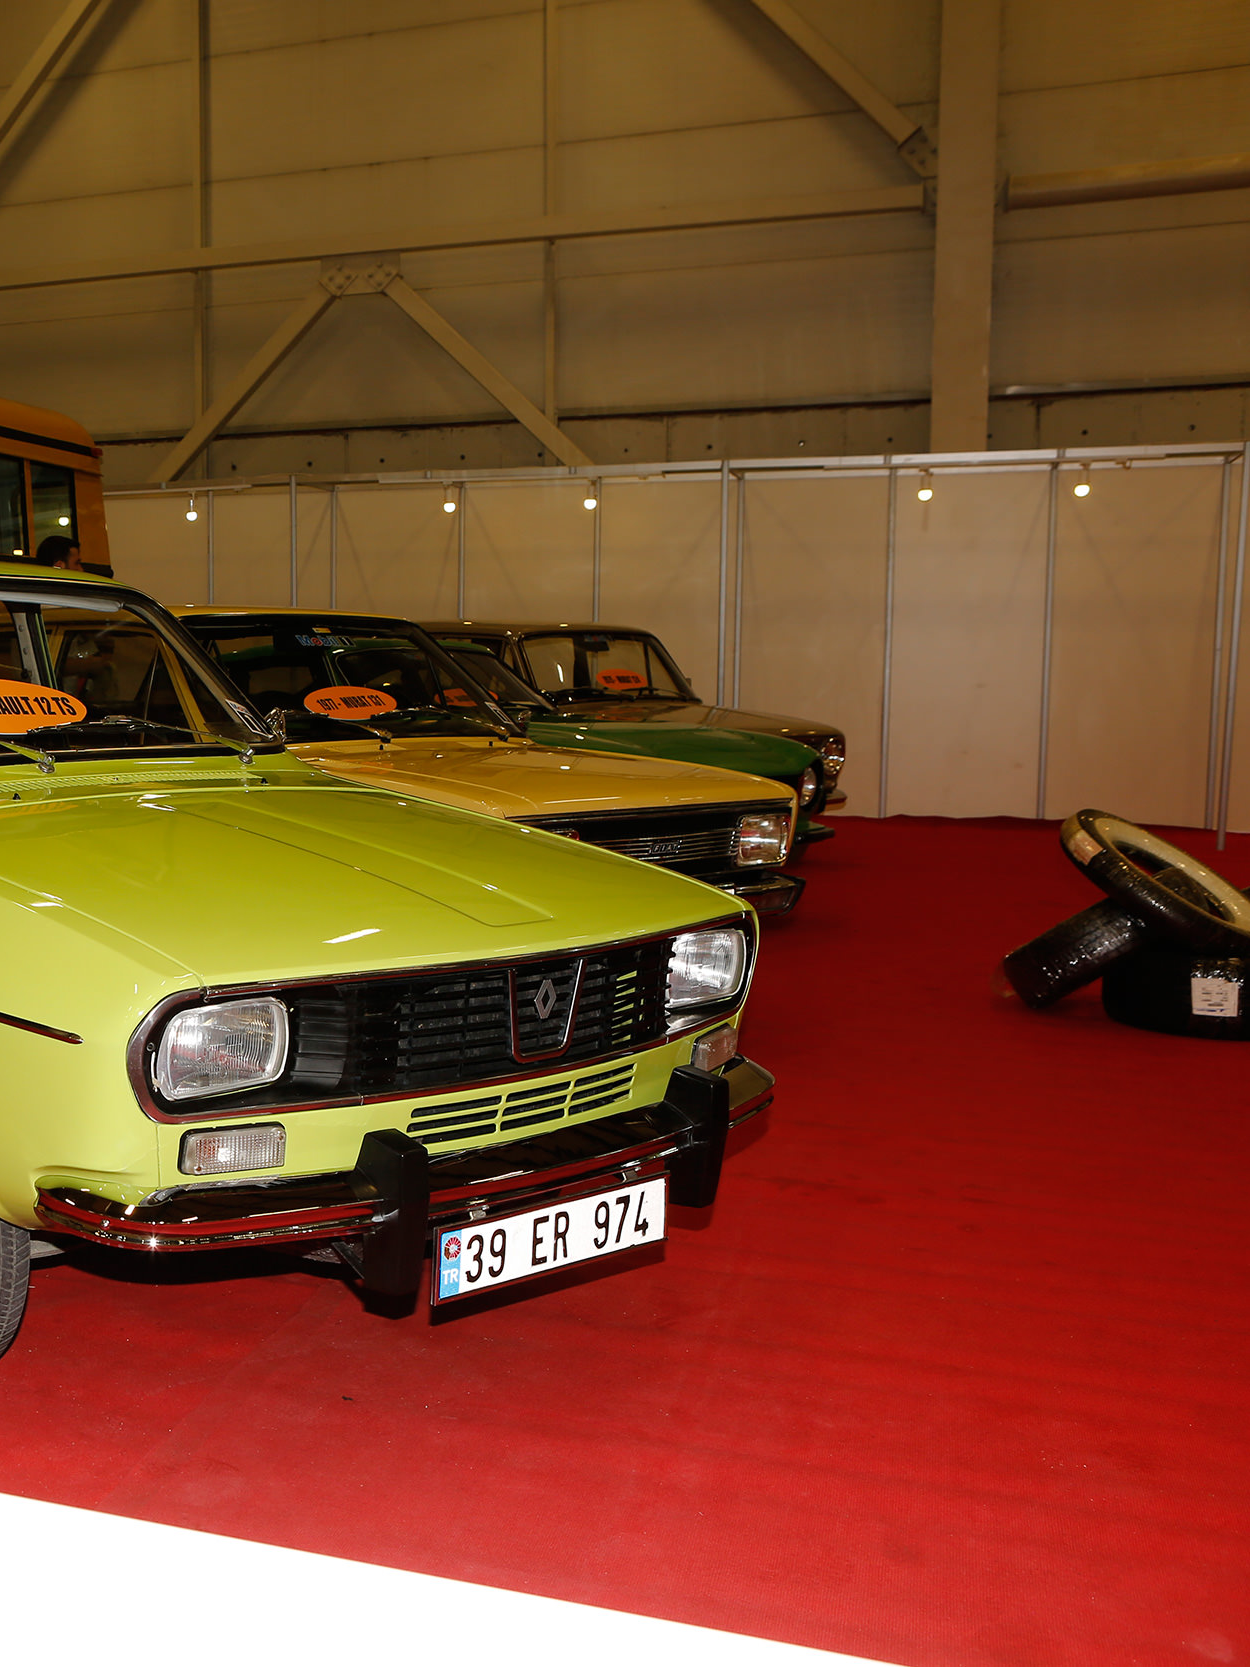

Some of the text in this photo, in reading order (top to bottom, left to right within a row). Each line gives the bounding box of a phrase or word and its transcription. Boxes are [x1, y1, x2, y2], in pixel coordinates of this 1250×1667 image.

[33, 696, 56, 715] 12
[52, 696, 77, 716] TS
[442, 1190, 649, 1285] TR 39 ER 974
